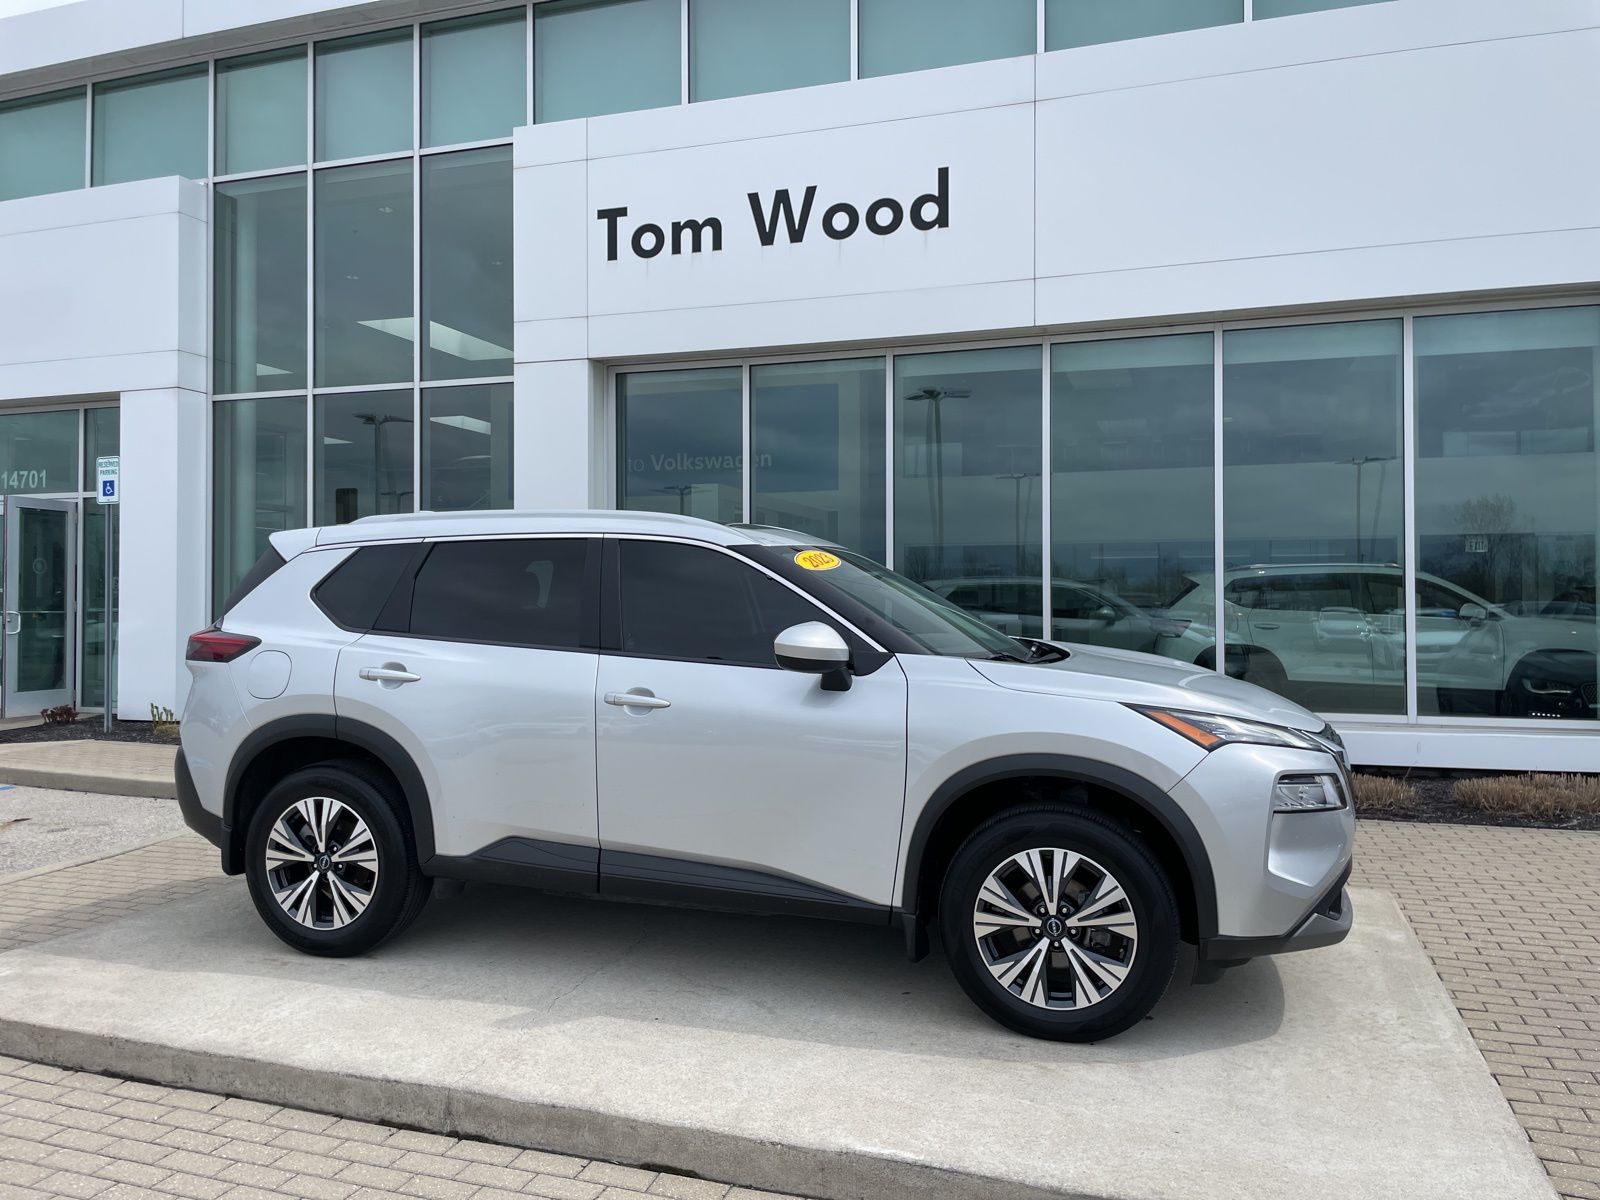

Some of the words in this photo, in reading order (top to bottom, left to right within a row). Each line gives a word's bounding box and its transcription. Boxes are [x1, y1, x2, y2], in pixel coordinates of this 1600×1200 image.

[597, 206, 722, 261] Tom
[747, 166, 949, 246] Wood
[1, 469, 47, 490] 14701
[802, 553, 834, 568] 2023
